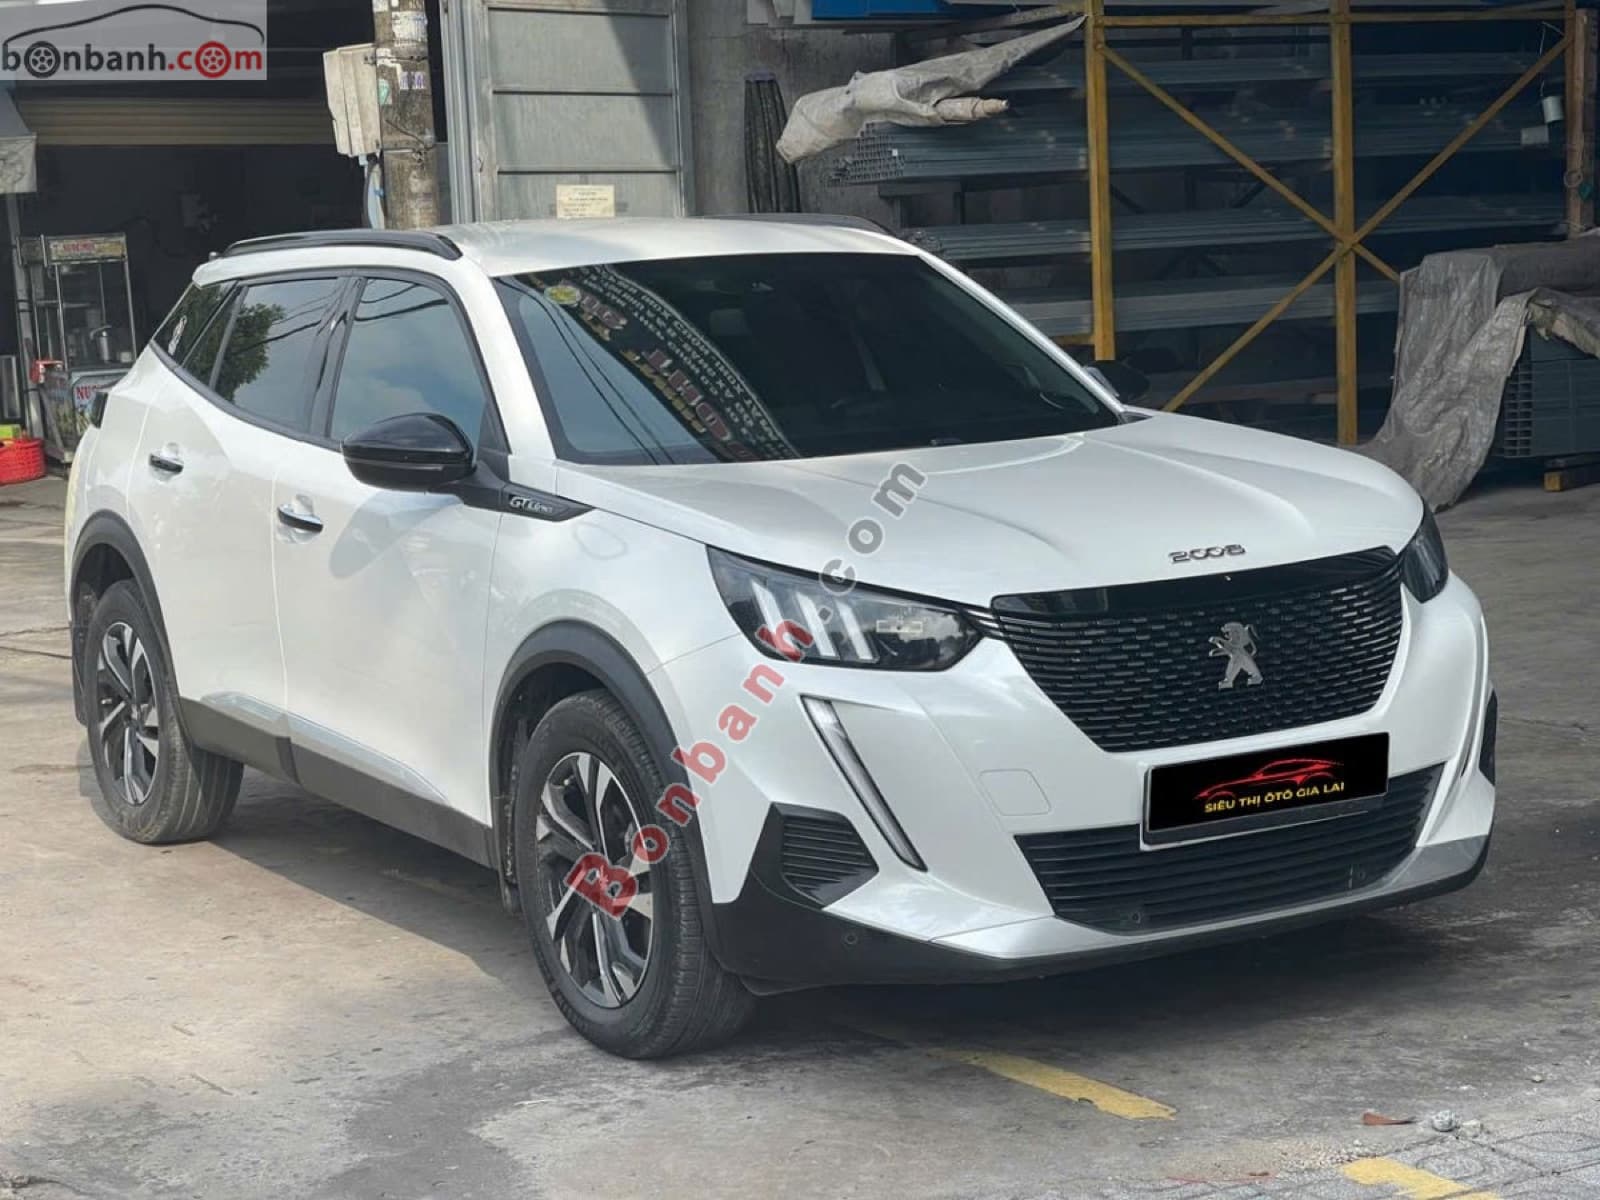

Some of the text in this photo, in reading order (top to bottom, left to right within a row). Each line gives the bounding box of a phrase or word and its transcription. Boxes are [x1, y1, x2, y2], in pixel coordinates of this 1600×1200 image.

[1168, 544, 1246, 563] 2008
[1204, 782, 1345, 813] SIÊU THỊ ÔTÔ GIA LAI
